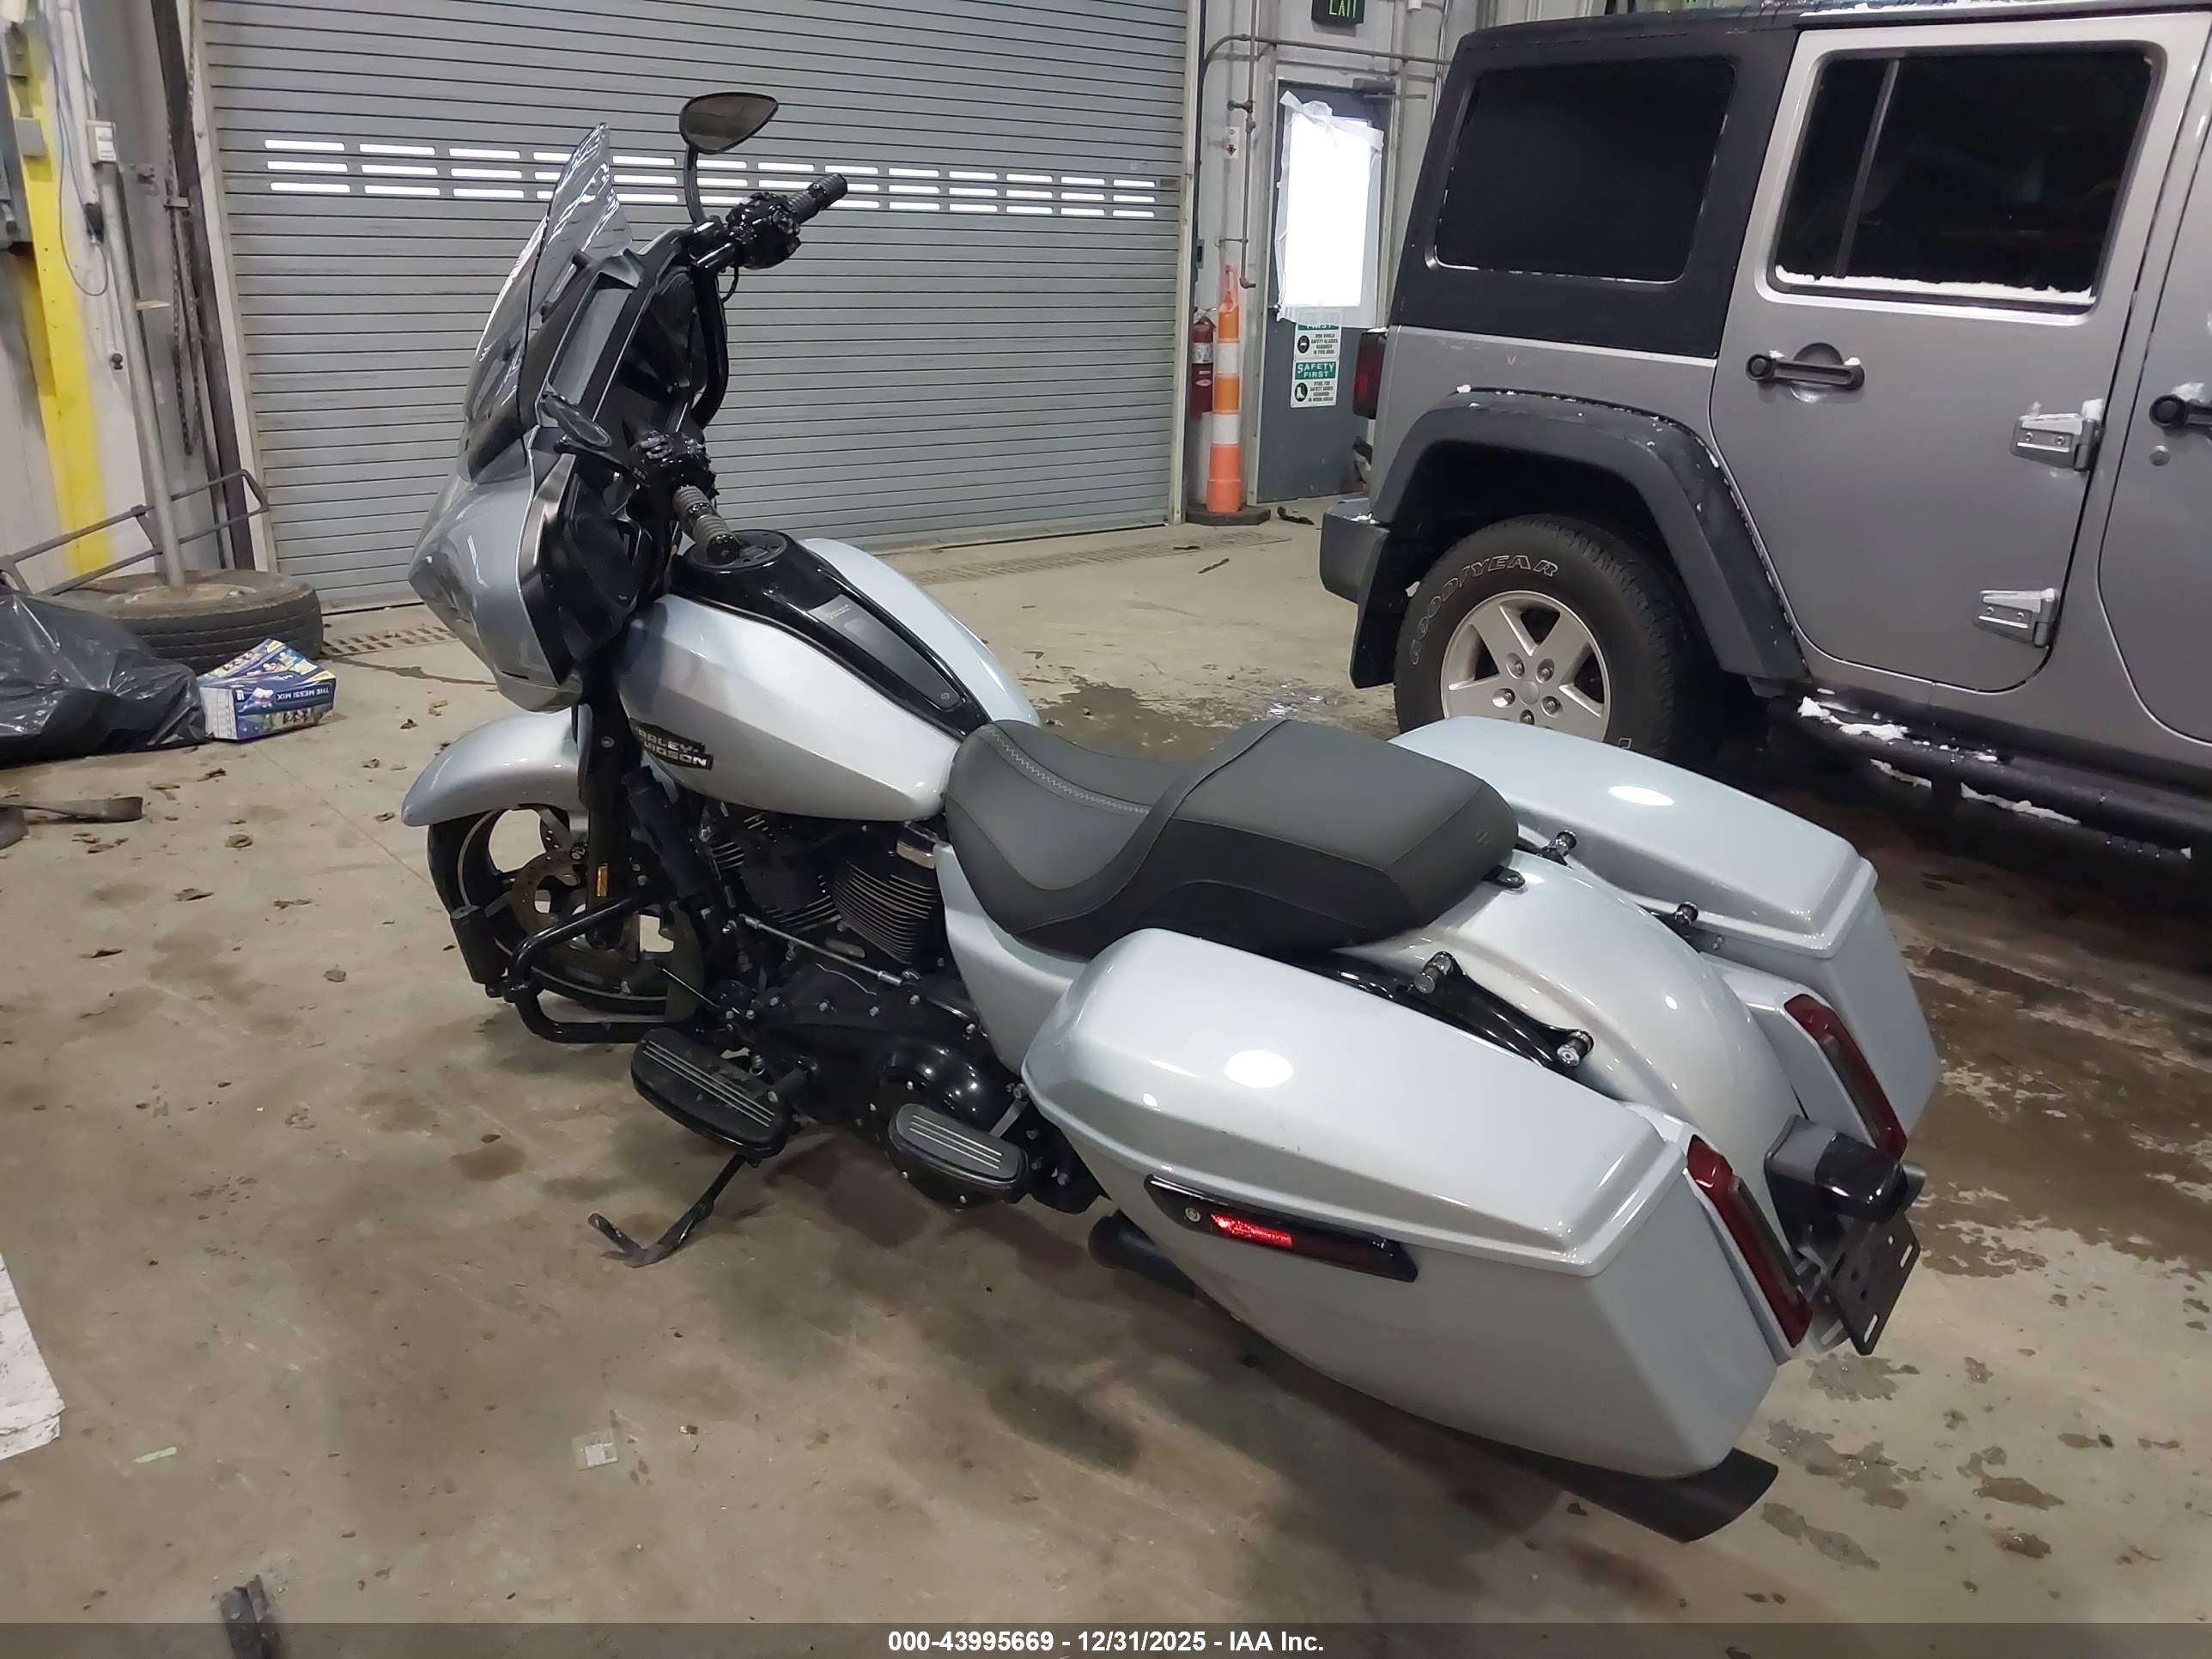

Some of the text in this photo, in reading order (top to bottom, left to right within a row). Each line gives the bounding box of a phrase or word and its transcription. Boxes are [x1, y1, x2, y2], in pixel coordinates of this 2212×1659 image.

[1297, 363, 1334, 374] SAFETY
[1409, 555, 1559, 665] GOODYEAR
[276, 687, 329, 701] THE MESSI MIX
[637, 728, 699, 753] ARLEY-
